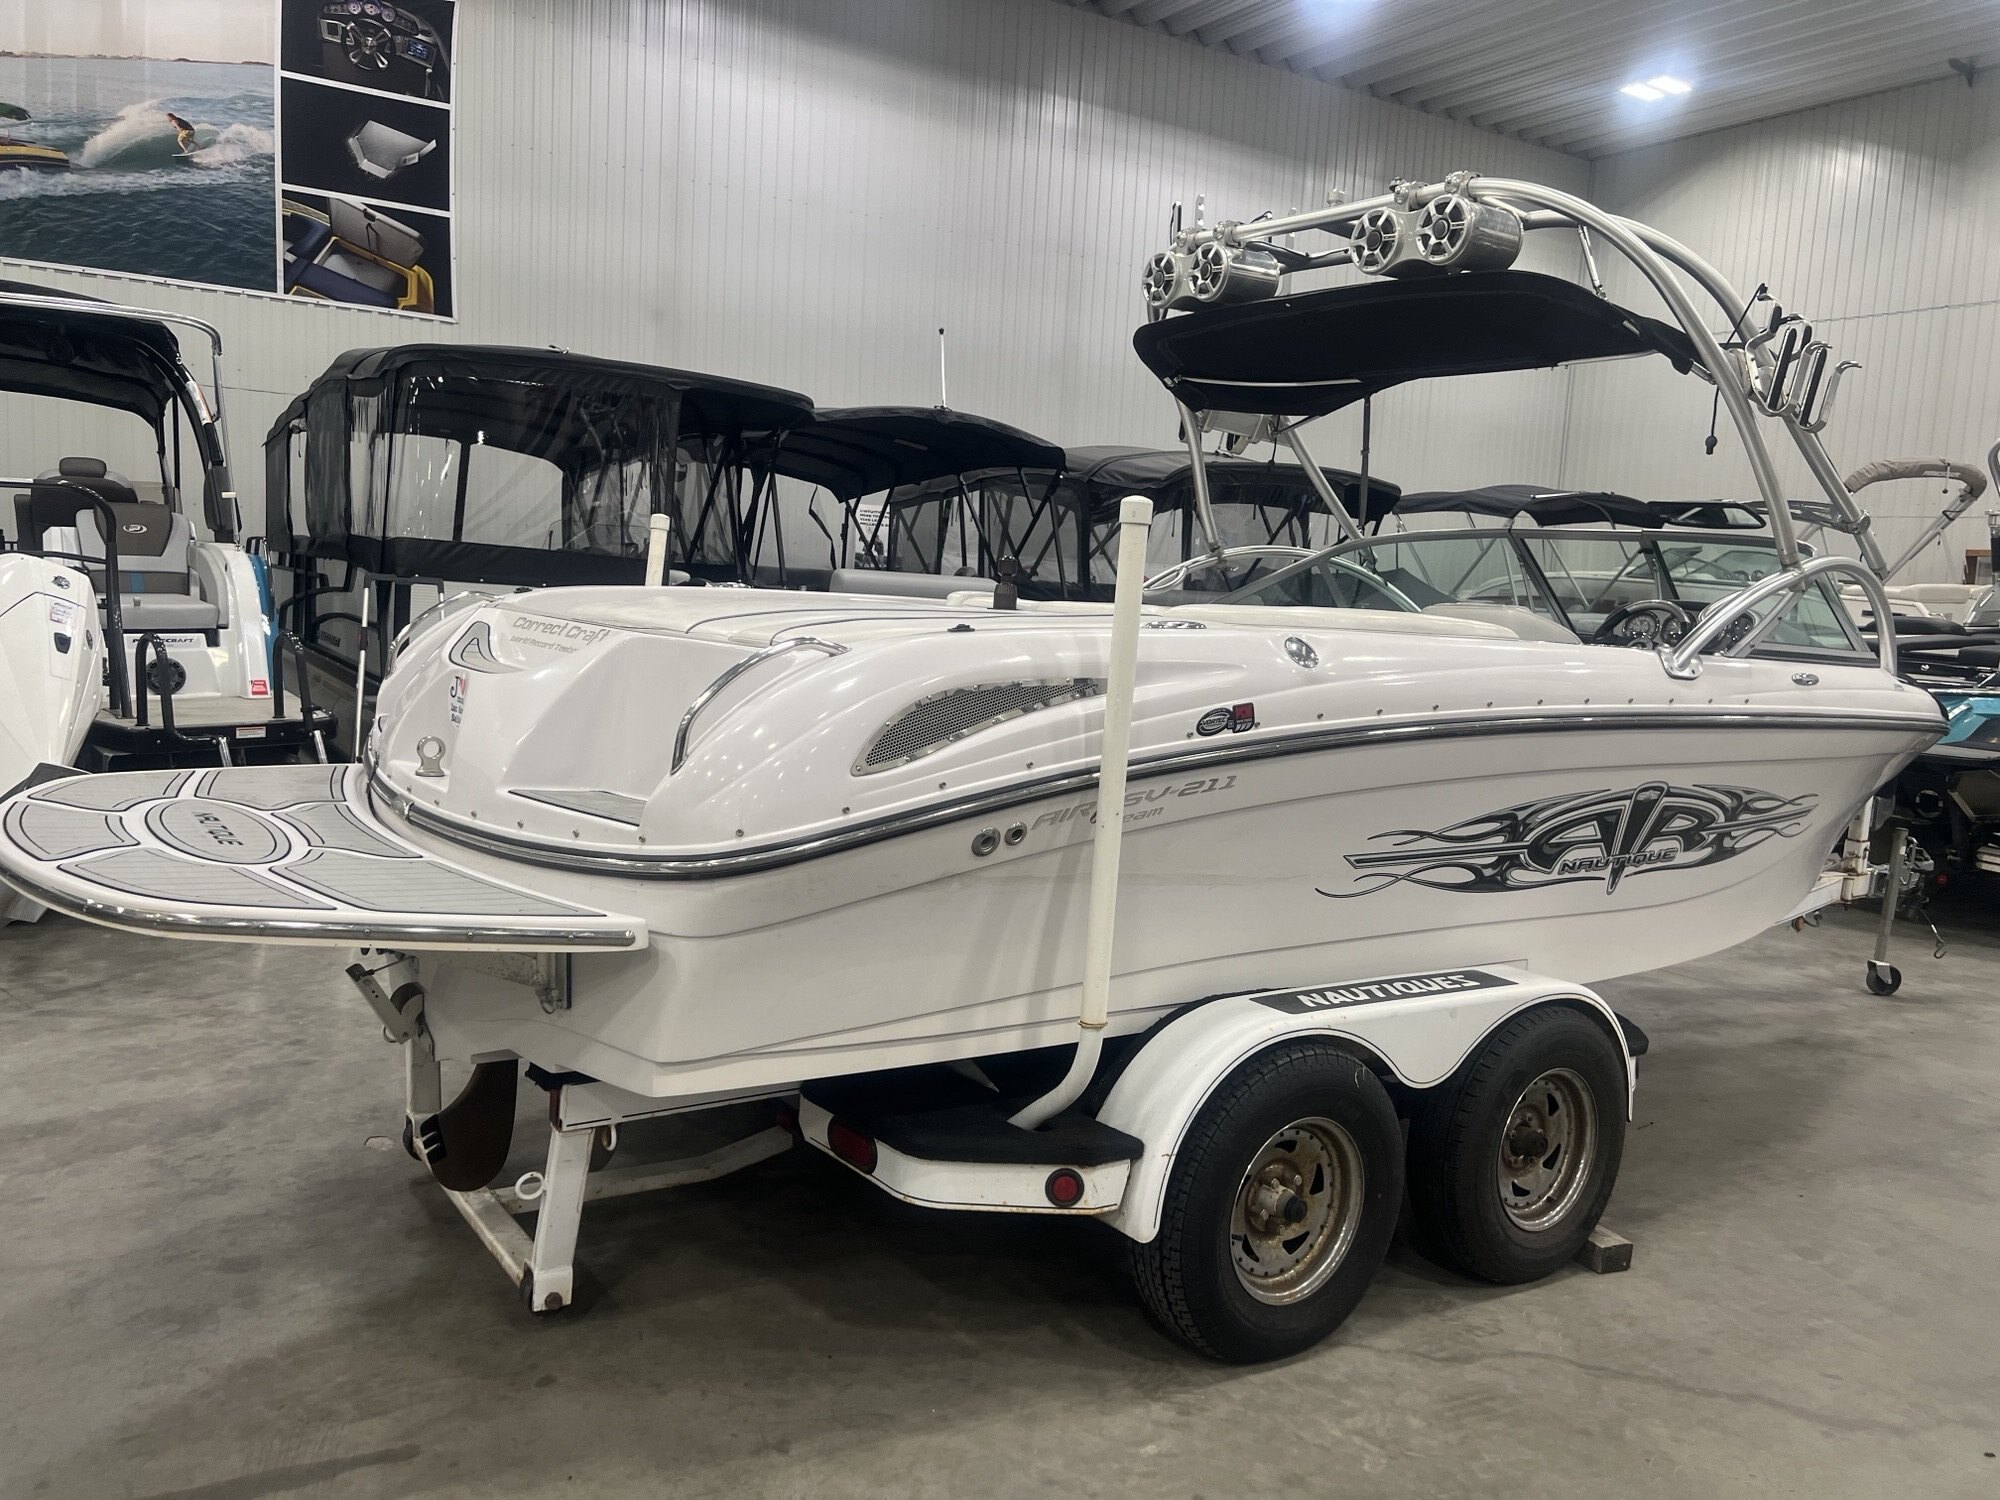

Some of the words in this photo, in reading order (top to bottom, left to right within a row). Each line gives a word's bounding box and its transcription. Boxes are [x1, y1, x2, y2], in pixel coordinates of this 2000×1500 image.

[512, 616, 569, 636] Correct
[565, 625, 611, 646] Craft
[191, 811, 244, 846] NAUTIQUE
[1121, 806, 1165, 824] eam
[1557, 846, 1680, 876] NAUTIQUE
[1297, 974, 1481, 1008] NAUTIQUES
